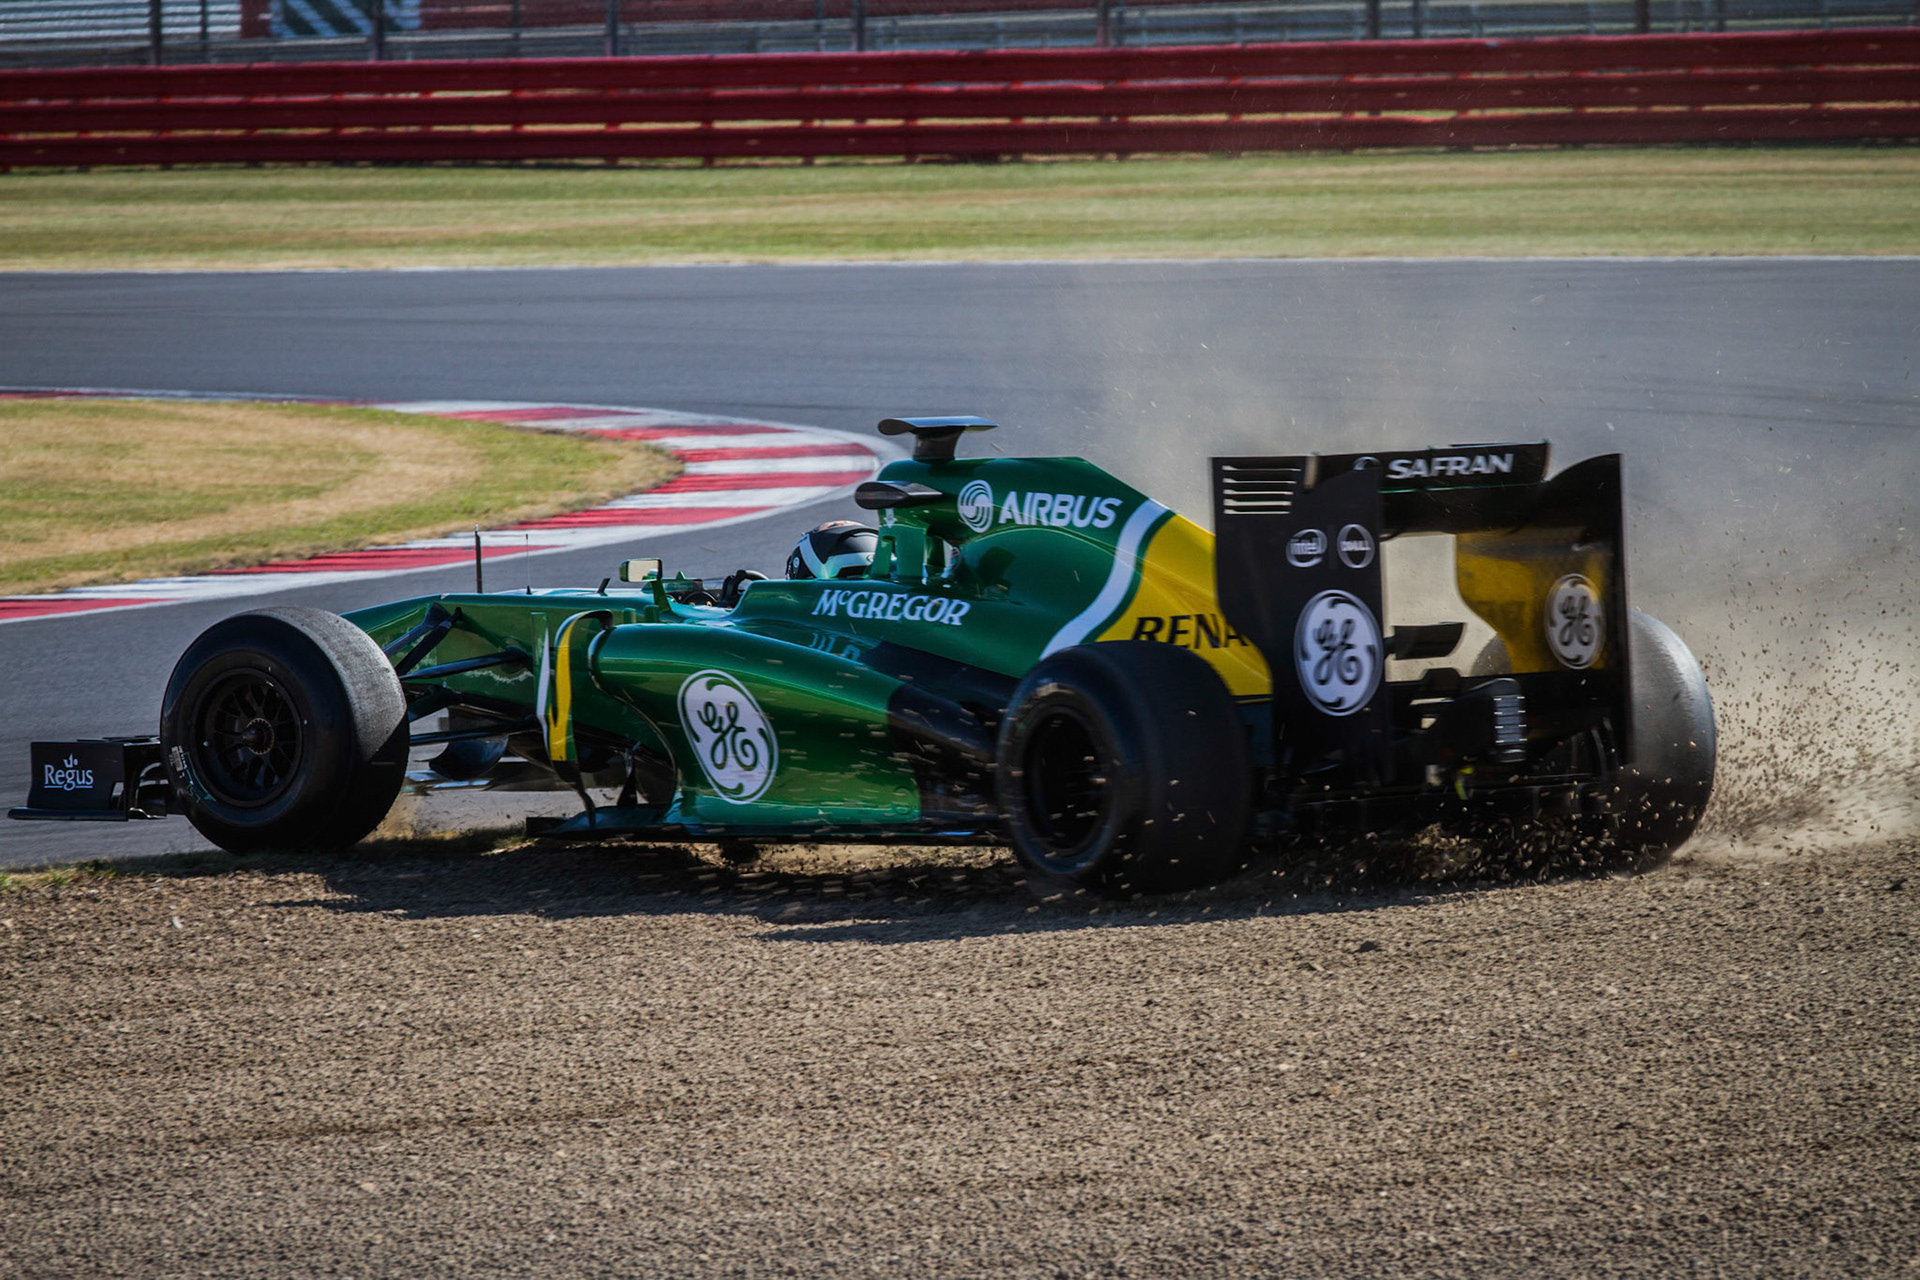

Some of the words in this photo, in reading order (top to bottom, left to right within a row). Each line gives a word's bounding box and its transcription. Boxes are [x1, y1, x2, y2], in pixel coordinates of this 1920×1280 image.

[1386, 453, 1513, 479] SAFRAN
[1000, 491, 1123, 528] AIRBUS
[44, 764, 94, 791] Regus
